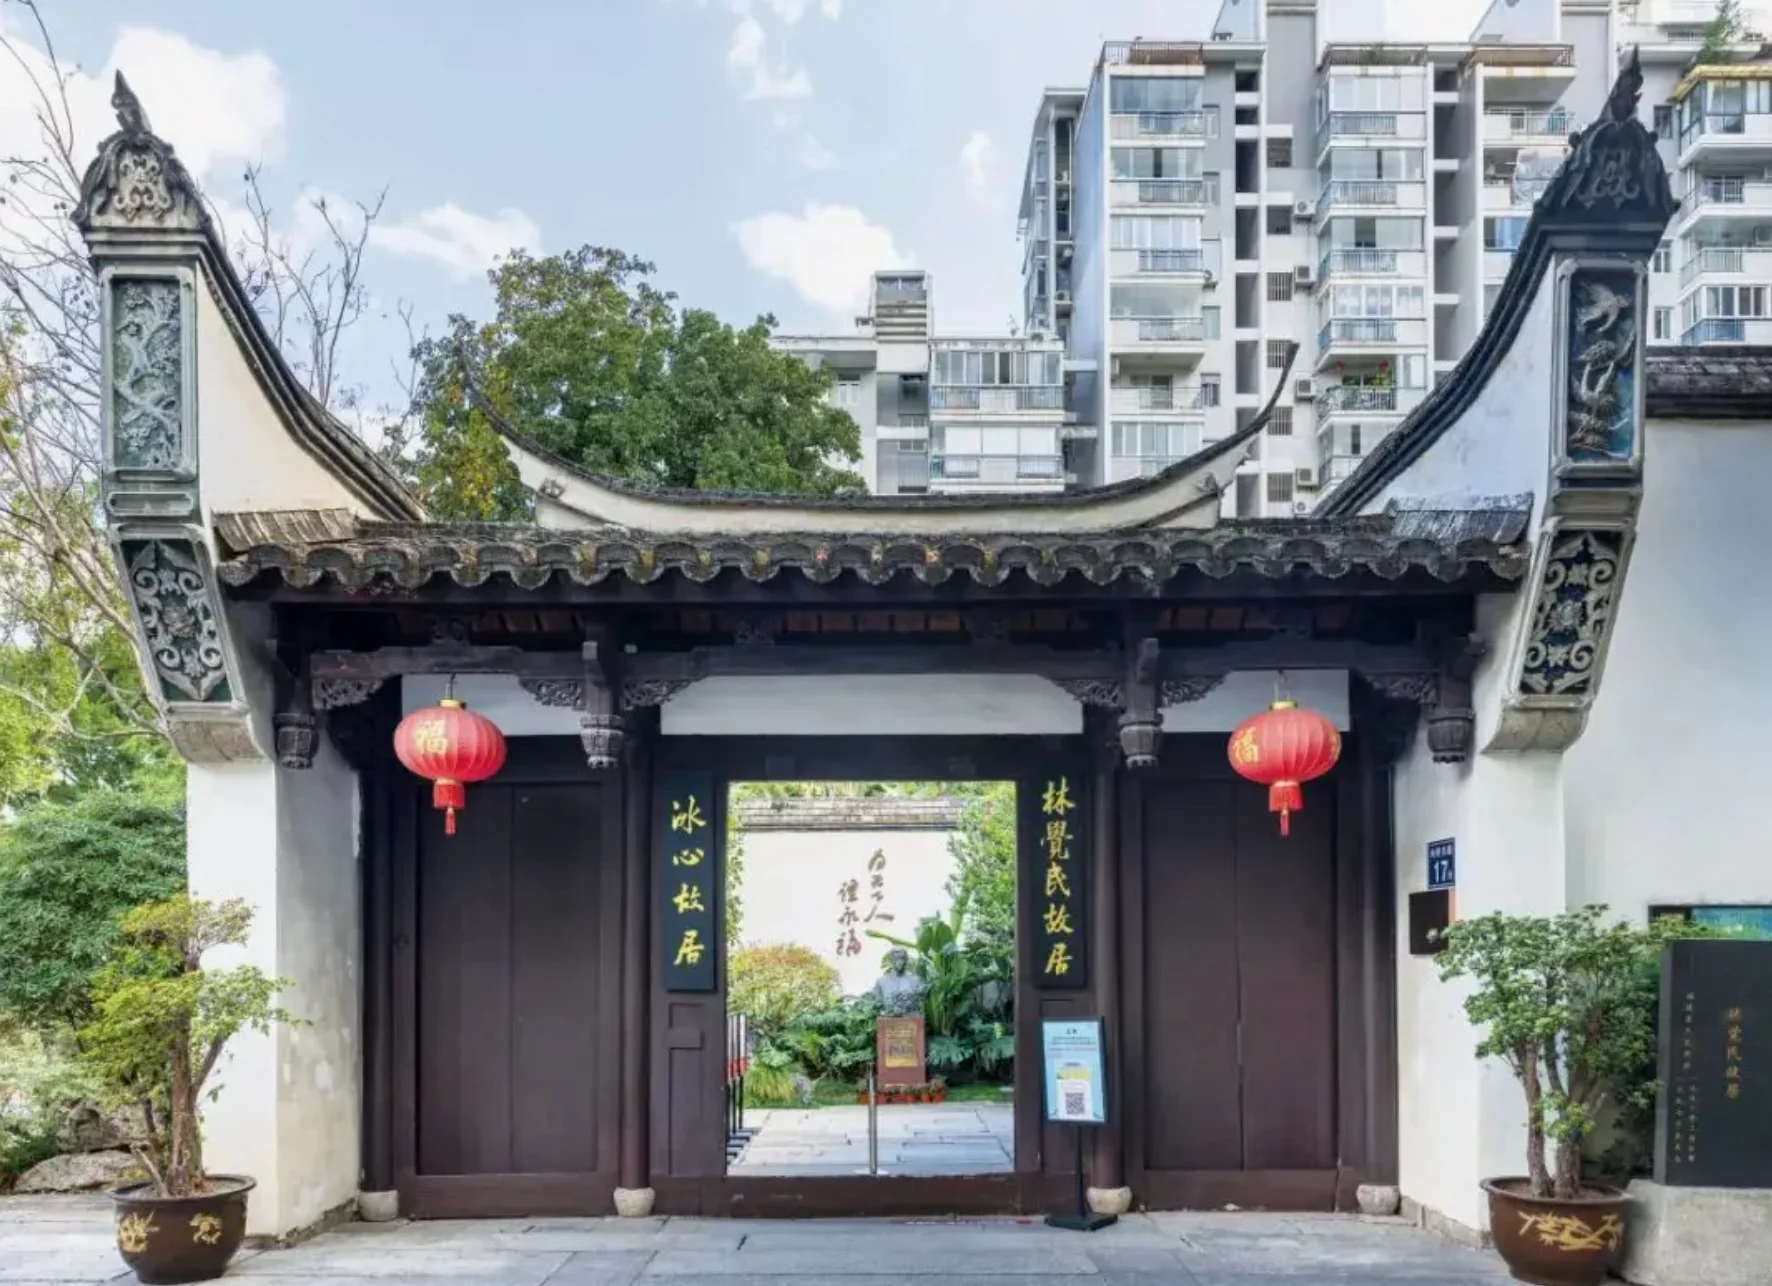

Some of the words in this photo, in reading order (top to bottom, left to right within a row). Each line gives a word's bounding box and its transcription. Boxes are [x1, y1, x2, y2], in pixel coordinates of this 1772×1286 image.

[671, 794, 707, 966] 冰心故居
[1040, 775, 1076, 976] 林覺民故居
